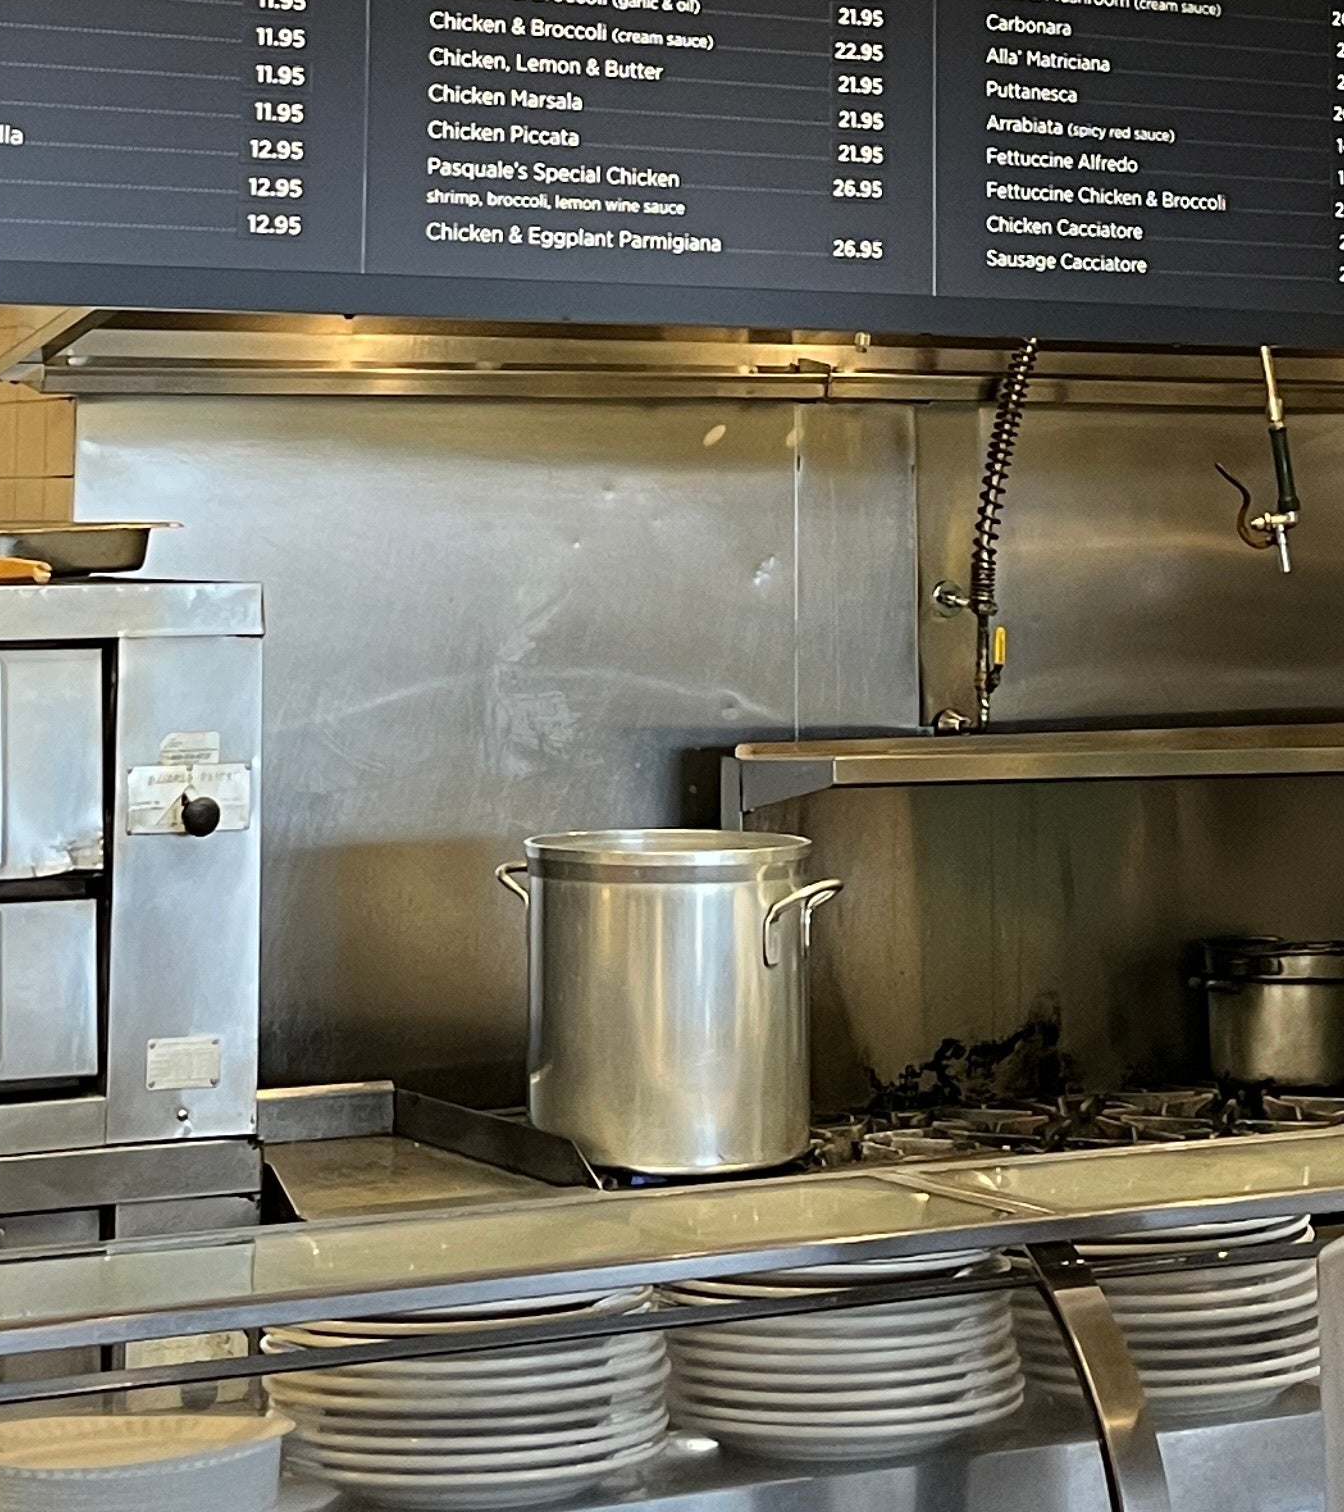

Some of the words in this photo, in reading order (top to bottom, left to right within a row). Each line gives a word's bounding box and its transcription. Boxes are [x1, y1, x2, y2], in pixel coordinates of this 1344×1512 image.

[986, 14, 1071, 36] Carbonara
[987, 81, 1077, 103] Puttanesca
[429, 84, 505, 105] Chicken
[511, 90, 582, 110] Marsala
[839, 110, 884, 130] 21.95
